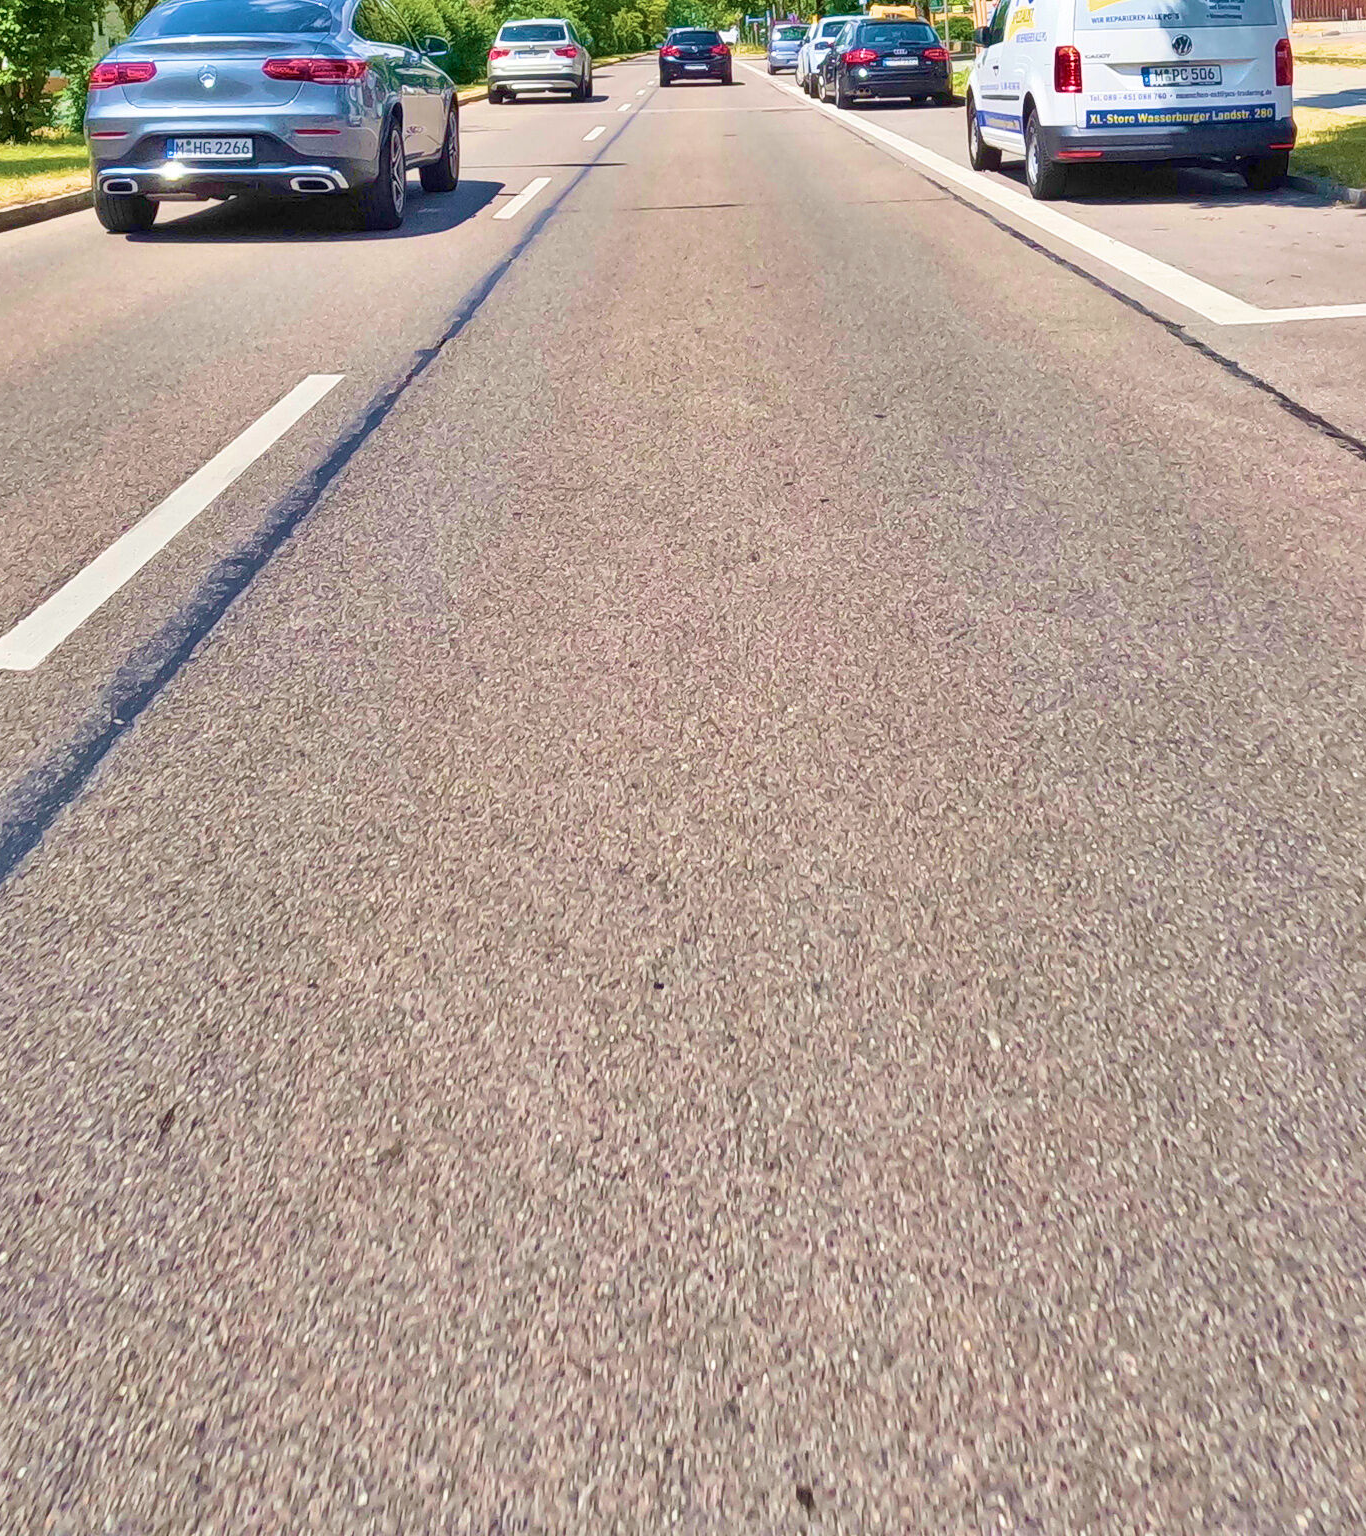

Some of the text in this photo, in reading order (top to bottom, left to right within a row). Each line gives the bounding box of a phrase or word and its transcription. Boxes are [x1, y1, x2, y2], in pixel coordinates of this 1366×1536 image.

[1106, 14, 1145, 23] REPARIEREN
[1172, 68, 1189, 81] PC
[1193, 67, 1215, 80] 506
[1090, 107, 1273, 124] XL-Store Wasserburger Landstr. 280
[176, 141, 249, 155] M HG 2266
